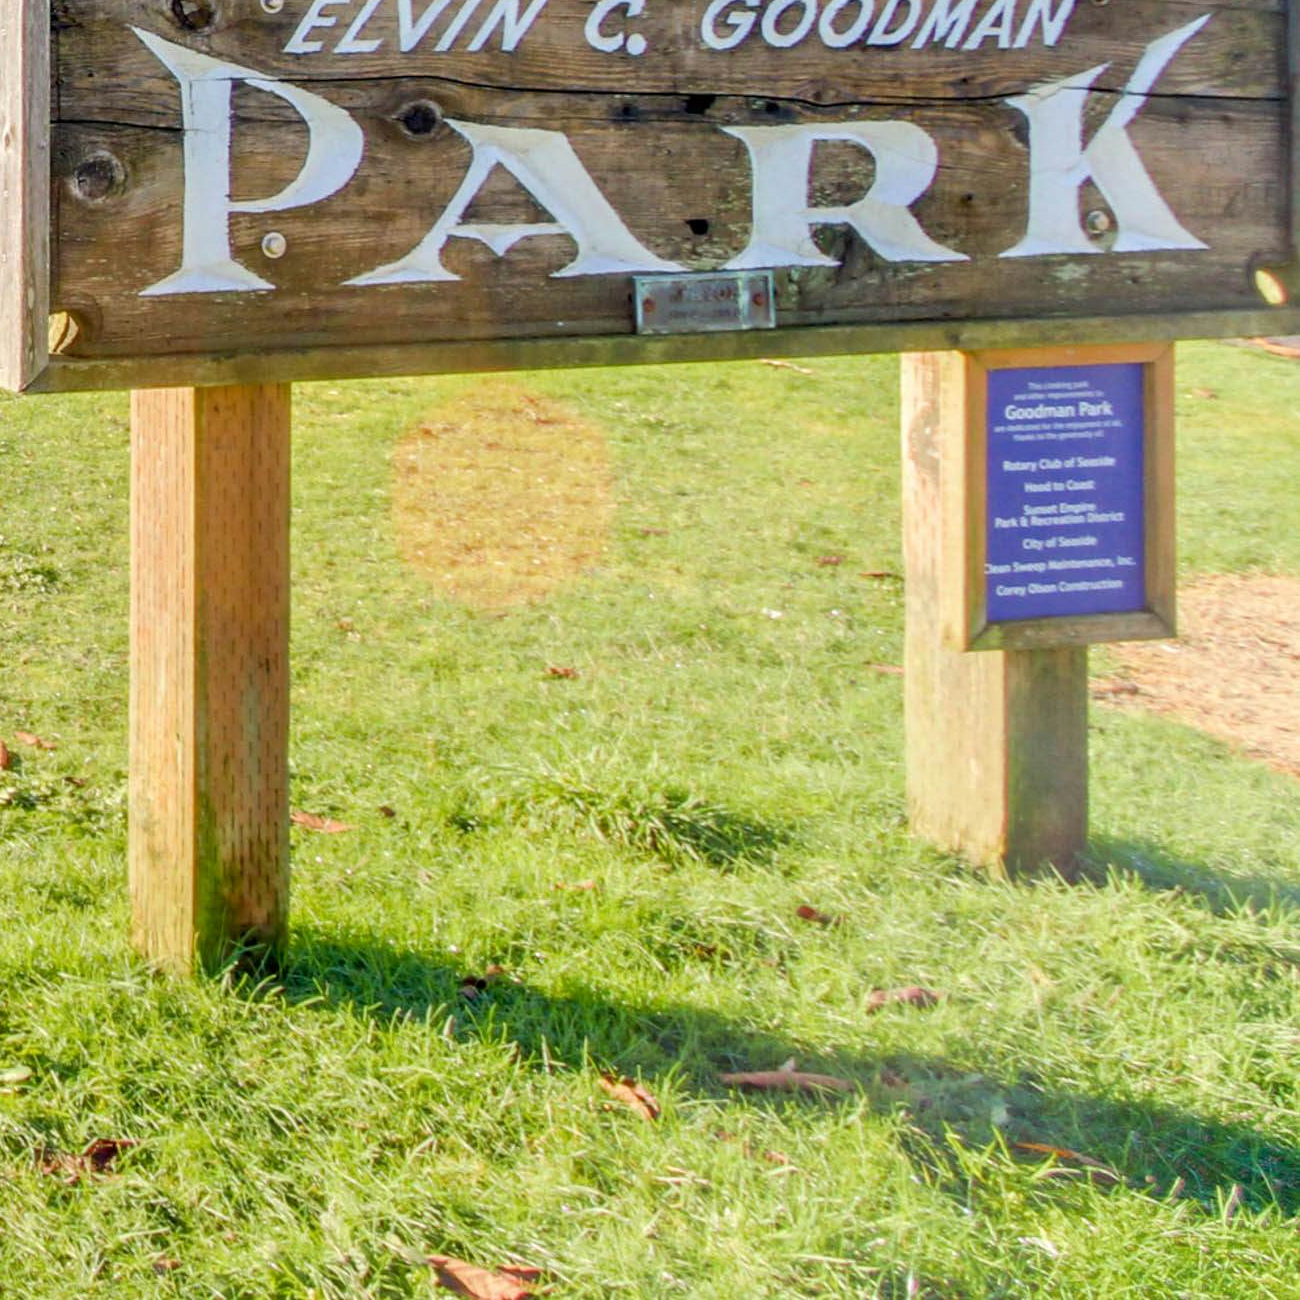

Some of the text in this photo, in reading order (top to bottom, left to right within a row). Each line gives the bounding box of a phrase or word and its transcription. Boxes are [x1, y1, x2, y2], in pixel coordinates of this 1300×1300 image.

[126, 12, 1214, 296] PARK
[1004, 400, 1114, 420] Goodman Park
[1002, 456, 1116, 472] Rotary Club of Seaside
[1053, 482, 1065, 492] to
[994, 517, 1019, 528] Park
[1022, 537, 1044, 551] City
[1045, 536, 1057, 548] of
[1116, 555, 1137, 566] Inc.
